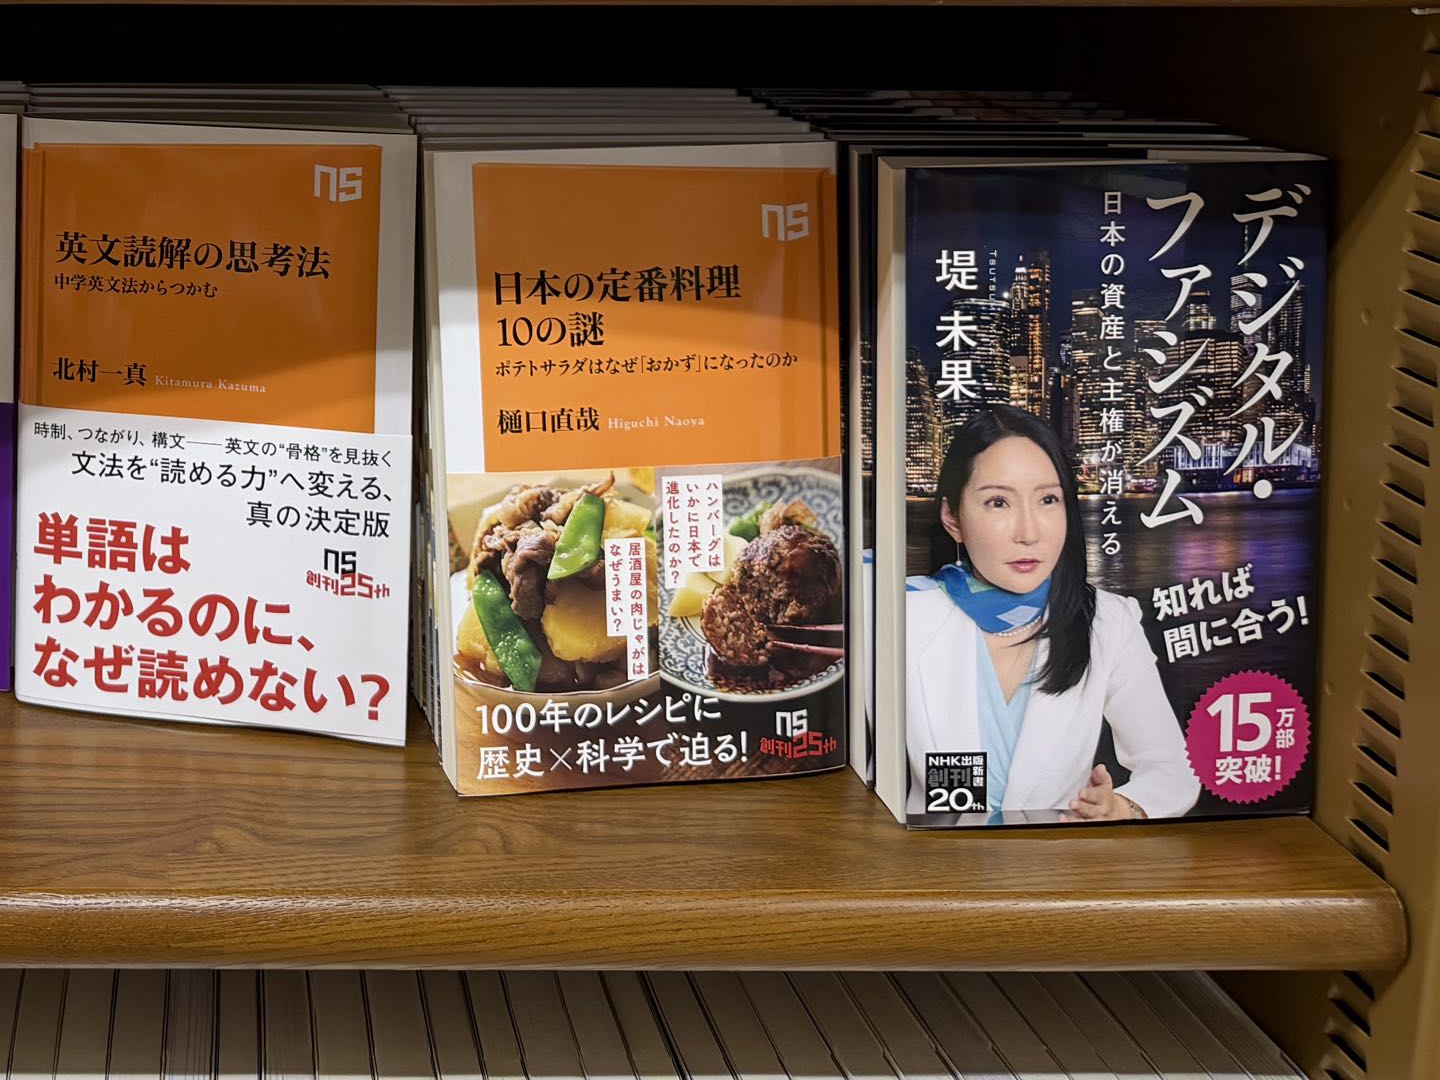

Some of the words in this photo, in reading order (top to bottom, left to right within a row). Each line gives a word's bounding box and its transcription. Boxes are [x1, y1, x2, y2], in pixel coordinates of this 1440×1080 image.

[56, 231, 330, 279] 英文読解の思考法
[54, 274, 218, 298] 中学英文法からつかむ
[495, 264, 741, 306] 日本の定番料理
[497, 312, 604, 347] 10の謎
[936, 250, 978, 400] 堤未果
[52, 358, 147, 387] 北村一真
[496, 351, 797, 377] ポテトサラダはなぜ「おかず」になったのか
[1099, 192, 1125, 555] 日本の資産と主権が消える
[1136, 192, 1214, 528] ファシズム
[155, 375, 212, 389] Kitamura
[219, 379, 266, 393] Kazuma
[497, 408, 600, 434] 樋口直哉
[608, 416, 658, 430] Higuchi
[664, 415, 704, 428] Naoya
[246, 501, 390, 538] 真の決定版
[686, 483, 700, 567] いかに日本で
[705, 481, 720, 567] ハンバーグは
[34, 512, 190, 573] 単語は
[306, 570, 390, 599] 創刊25th
[1152, 563, 1254, 620] 知れば
[34, 574, 315, 652] わかるのに、
[628, 542, 645, 675] 居酒屋の肉じゃがは
[476, 694, 722, 735] 100年のレシピに
[760, 731, 837, 759] 創刊25th
